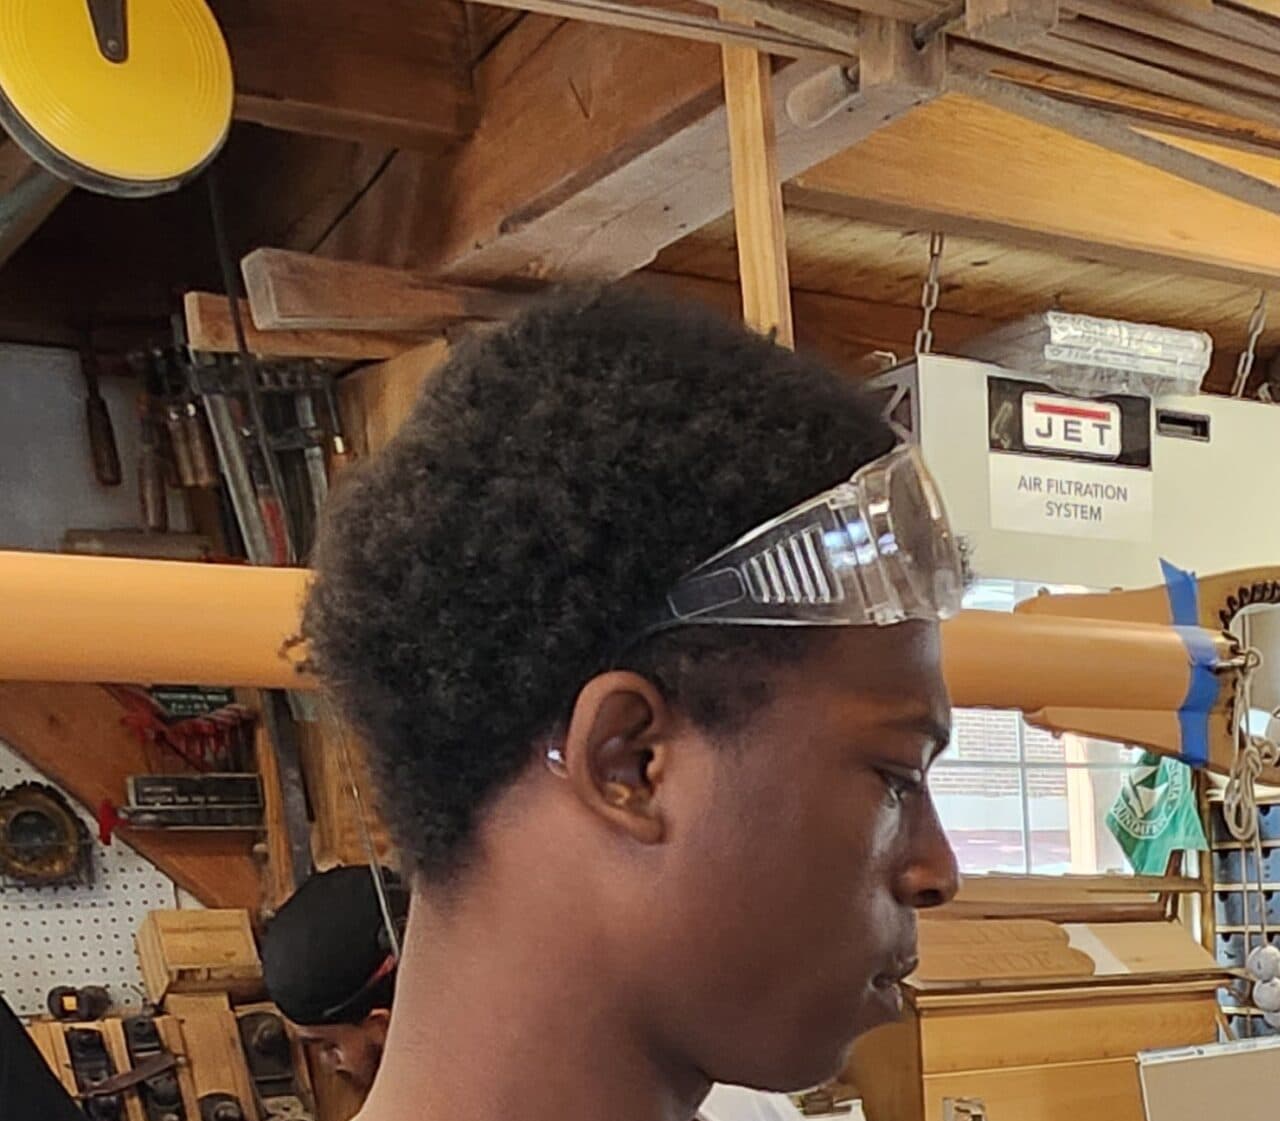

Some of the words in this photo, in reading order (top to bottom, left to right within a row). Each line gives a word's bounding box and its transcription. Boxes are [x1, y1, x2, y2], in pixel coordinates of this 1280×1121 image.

[1035, 417, 1112, 446] JET
[1017, 475, 1042, 492] AIR
[1046, 478, 1128, 502] FILTRATION
[1045, 501, 1102, 521] SYSTEM
